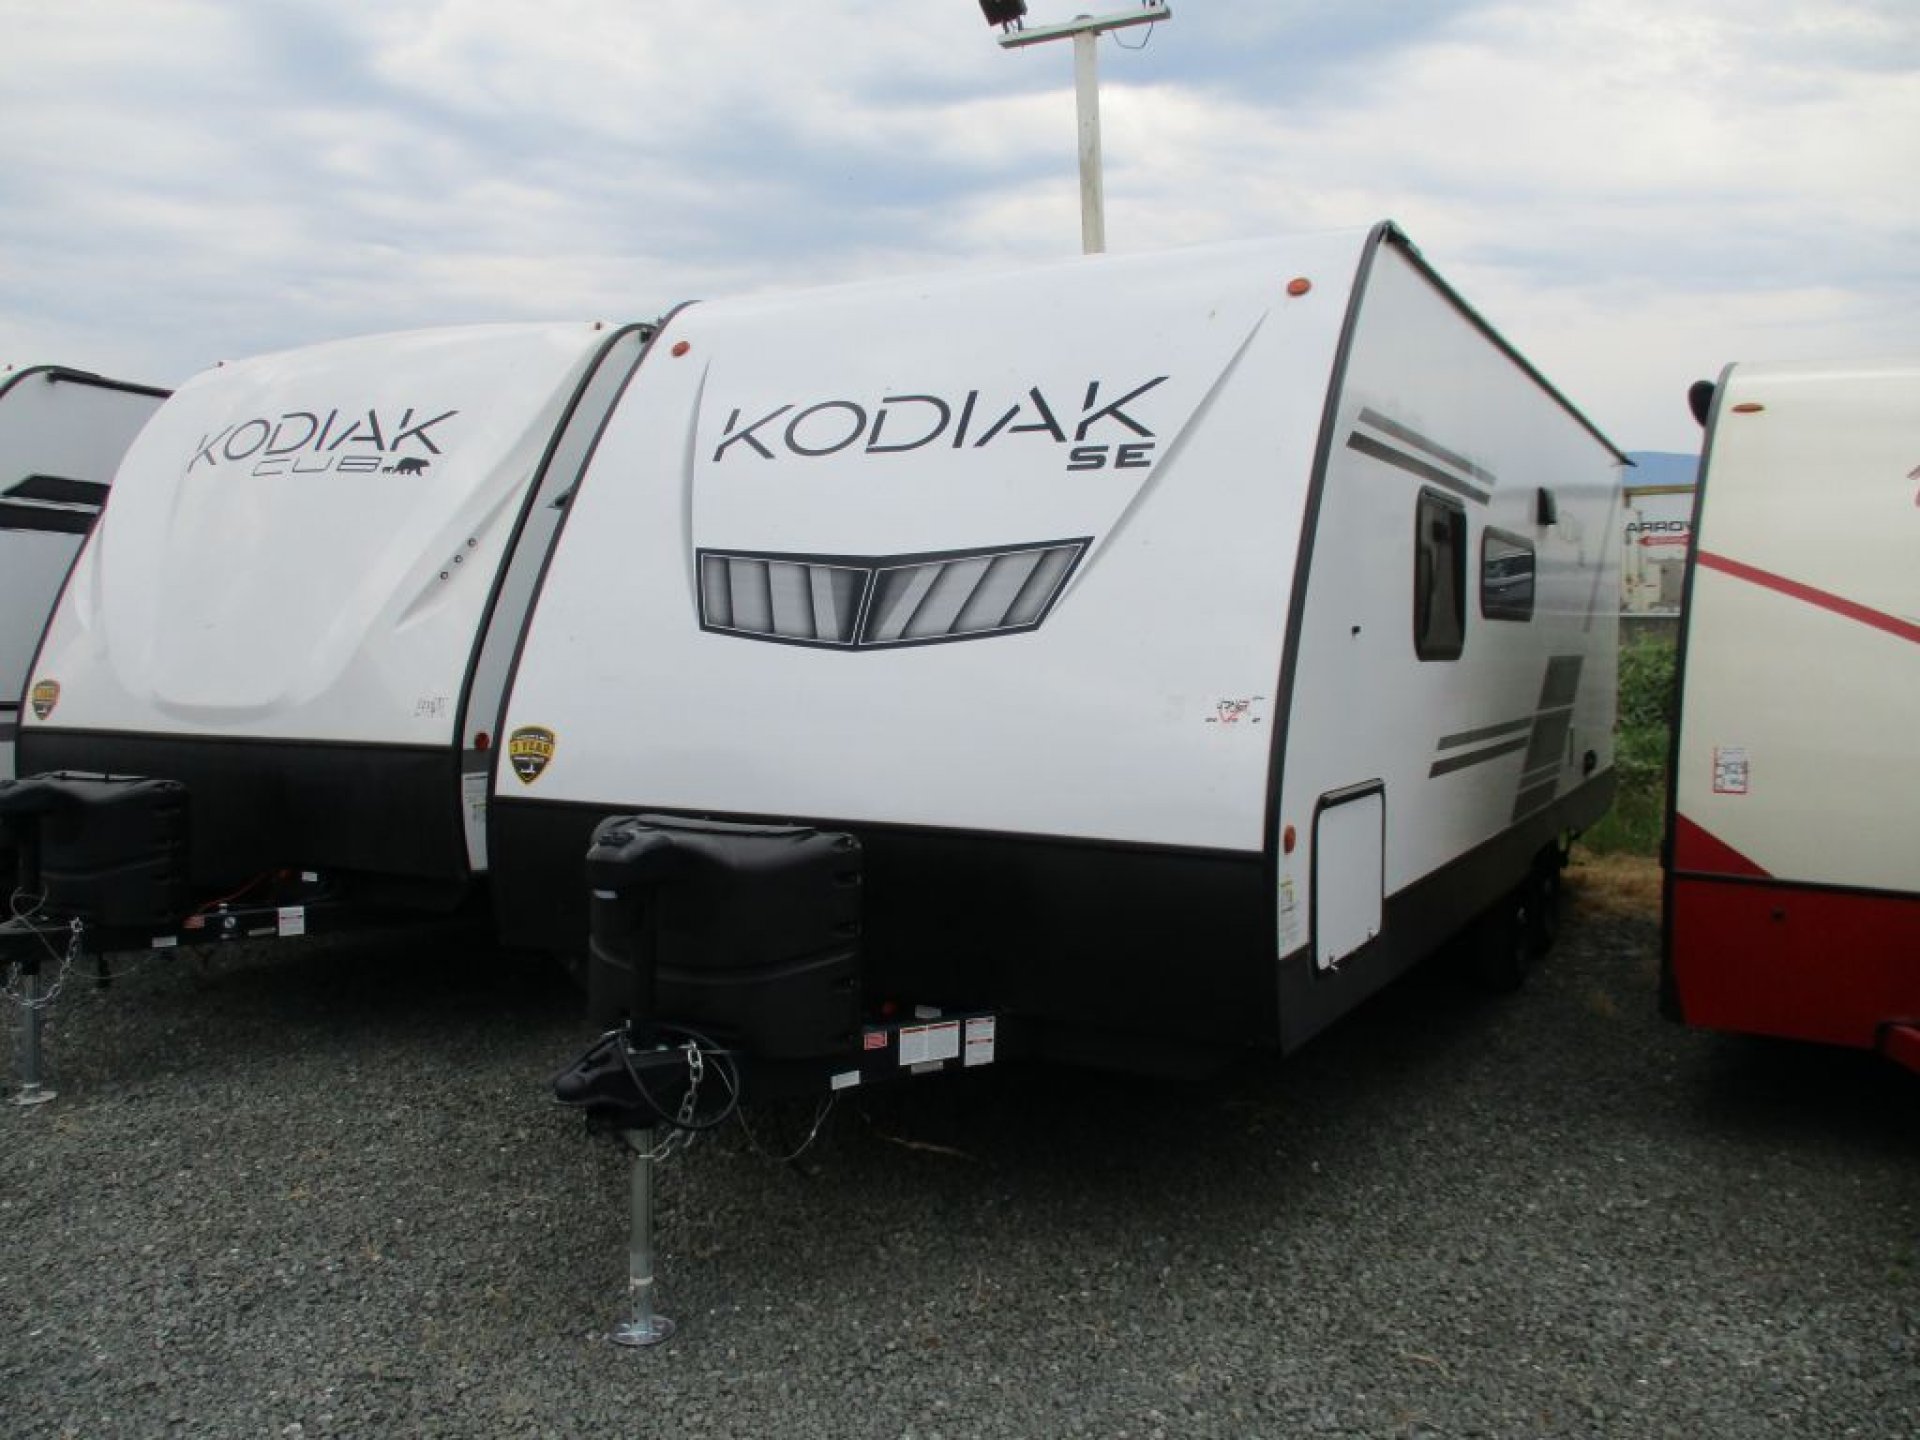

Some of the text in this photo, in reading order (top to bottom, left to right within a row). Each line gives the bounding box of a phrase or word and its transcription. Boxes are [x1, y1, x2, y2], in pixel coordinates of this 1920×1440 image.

[187, 408, 457, 474] KODIAK
[713, 375, 1170, 462] KODIAK
[252, 456, 382, 476] CUB
[1066, 442, 1156, 471] SE
